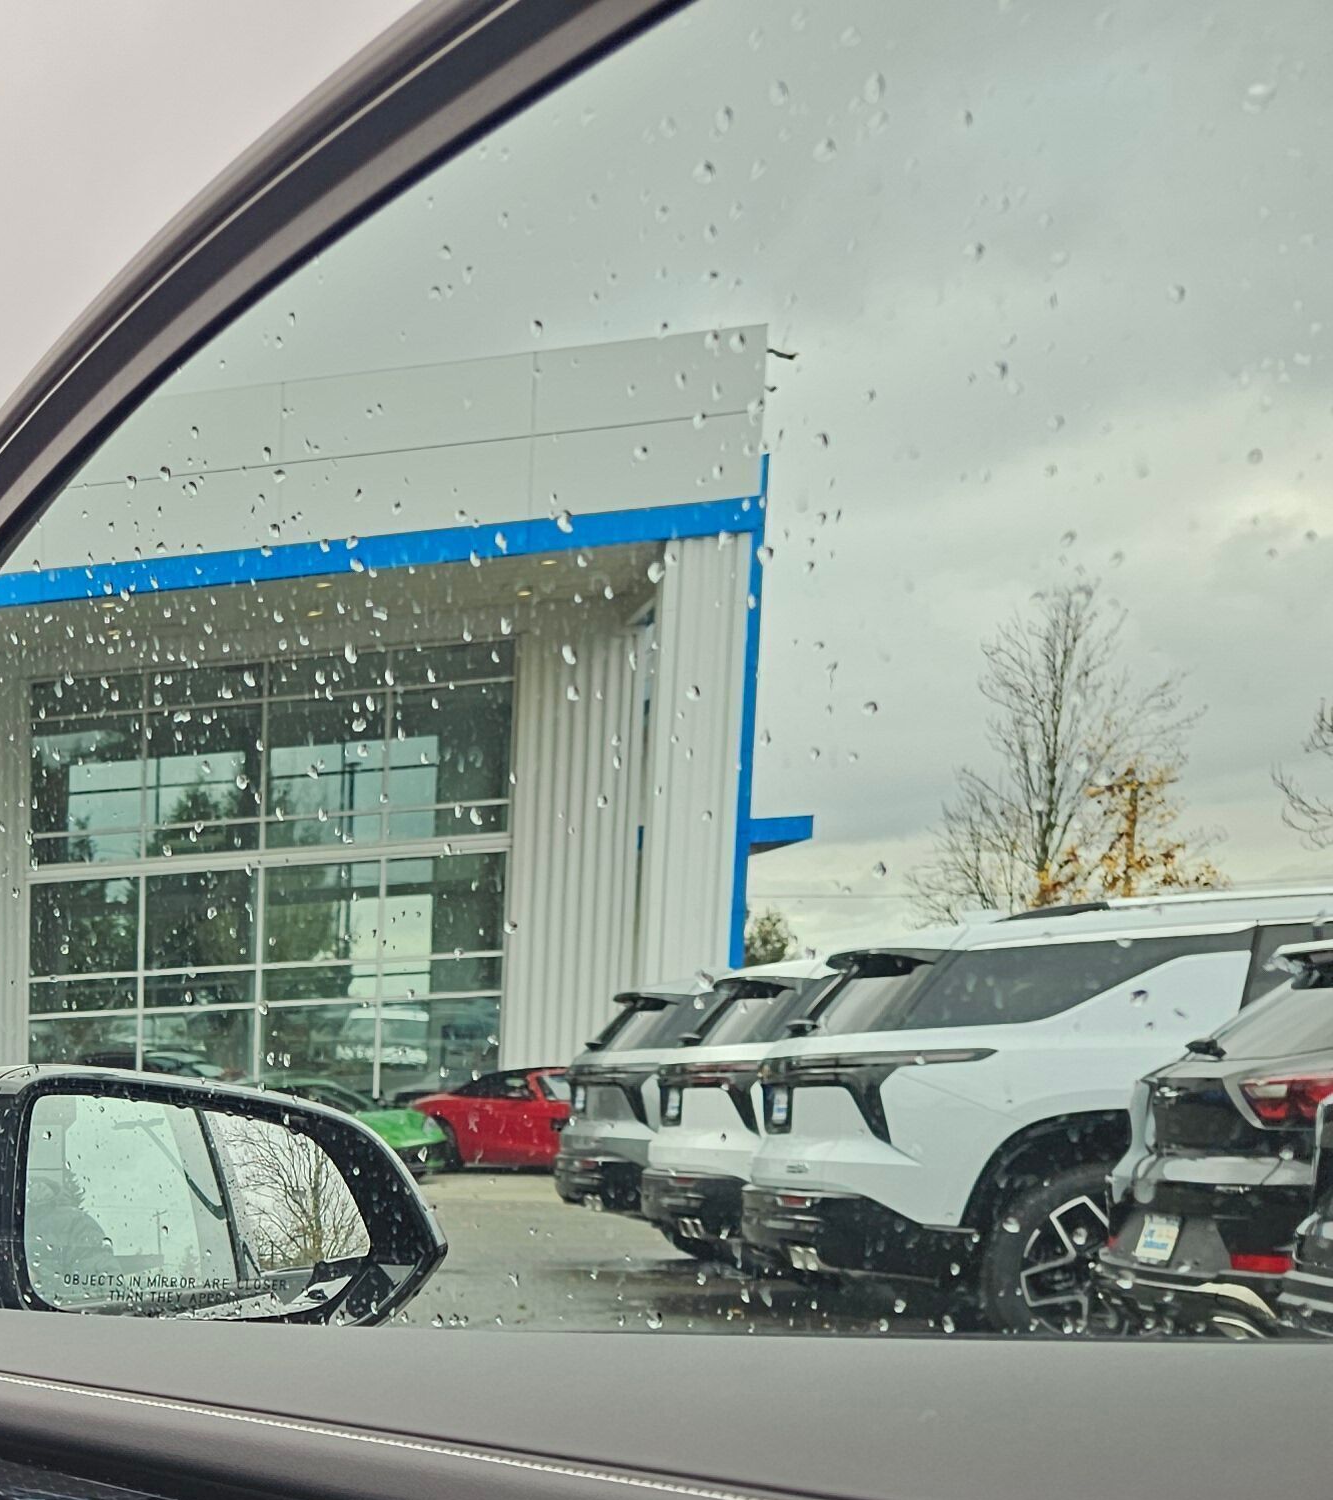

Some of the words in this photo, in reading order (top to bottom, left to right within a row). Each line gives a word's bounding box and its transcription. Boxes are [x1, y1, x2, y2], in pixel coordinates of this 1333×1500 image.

[63, 1274, 125, 1287] OBJECTS
[129, 1275, 141, 1287] IN
[147, 1275, 196, 1289] MIRROR
[203, 1278, 230, 1289] ARE
[236, 1278, 287, 1291] CLOSER
[109, 1290, 144, 1302] THAN
[150, 1291, 183, 1303] THEY
